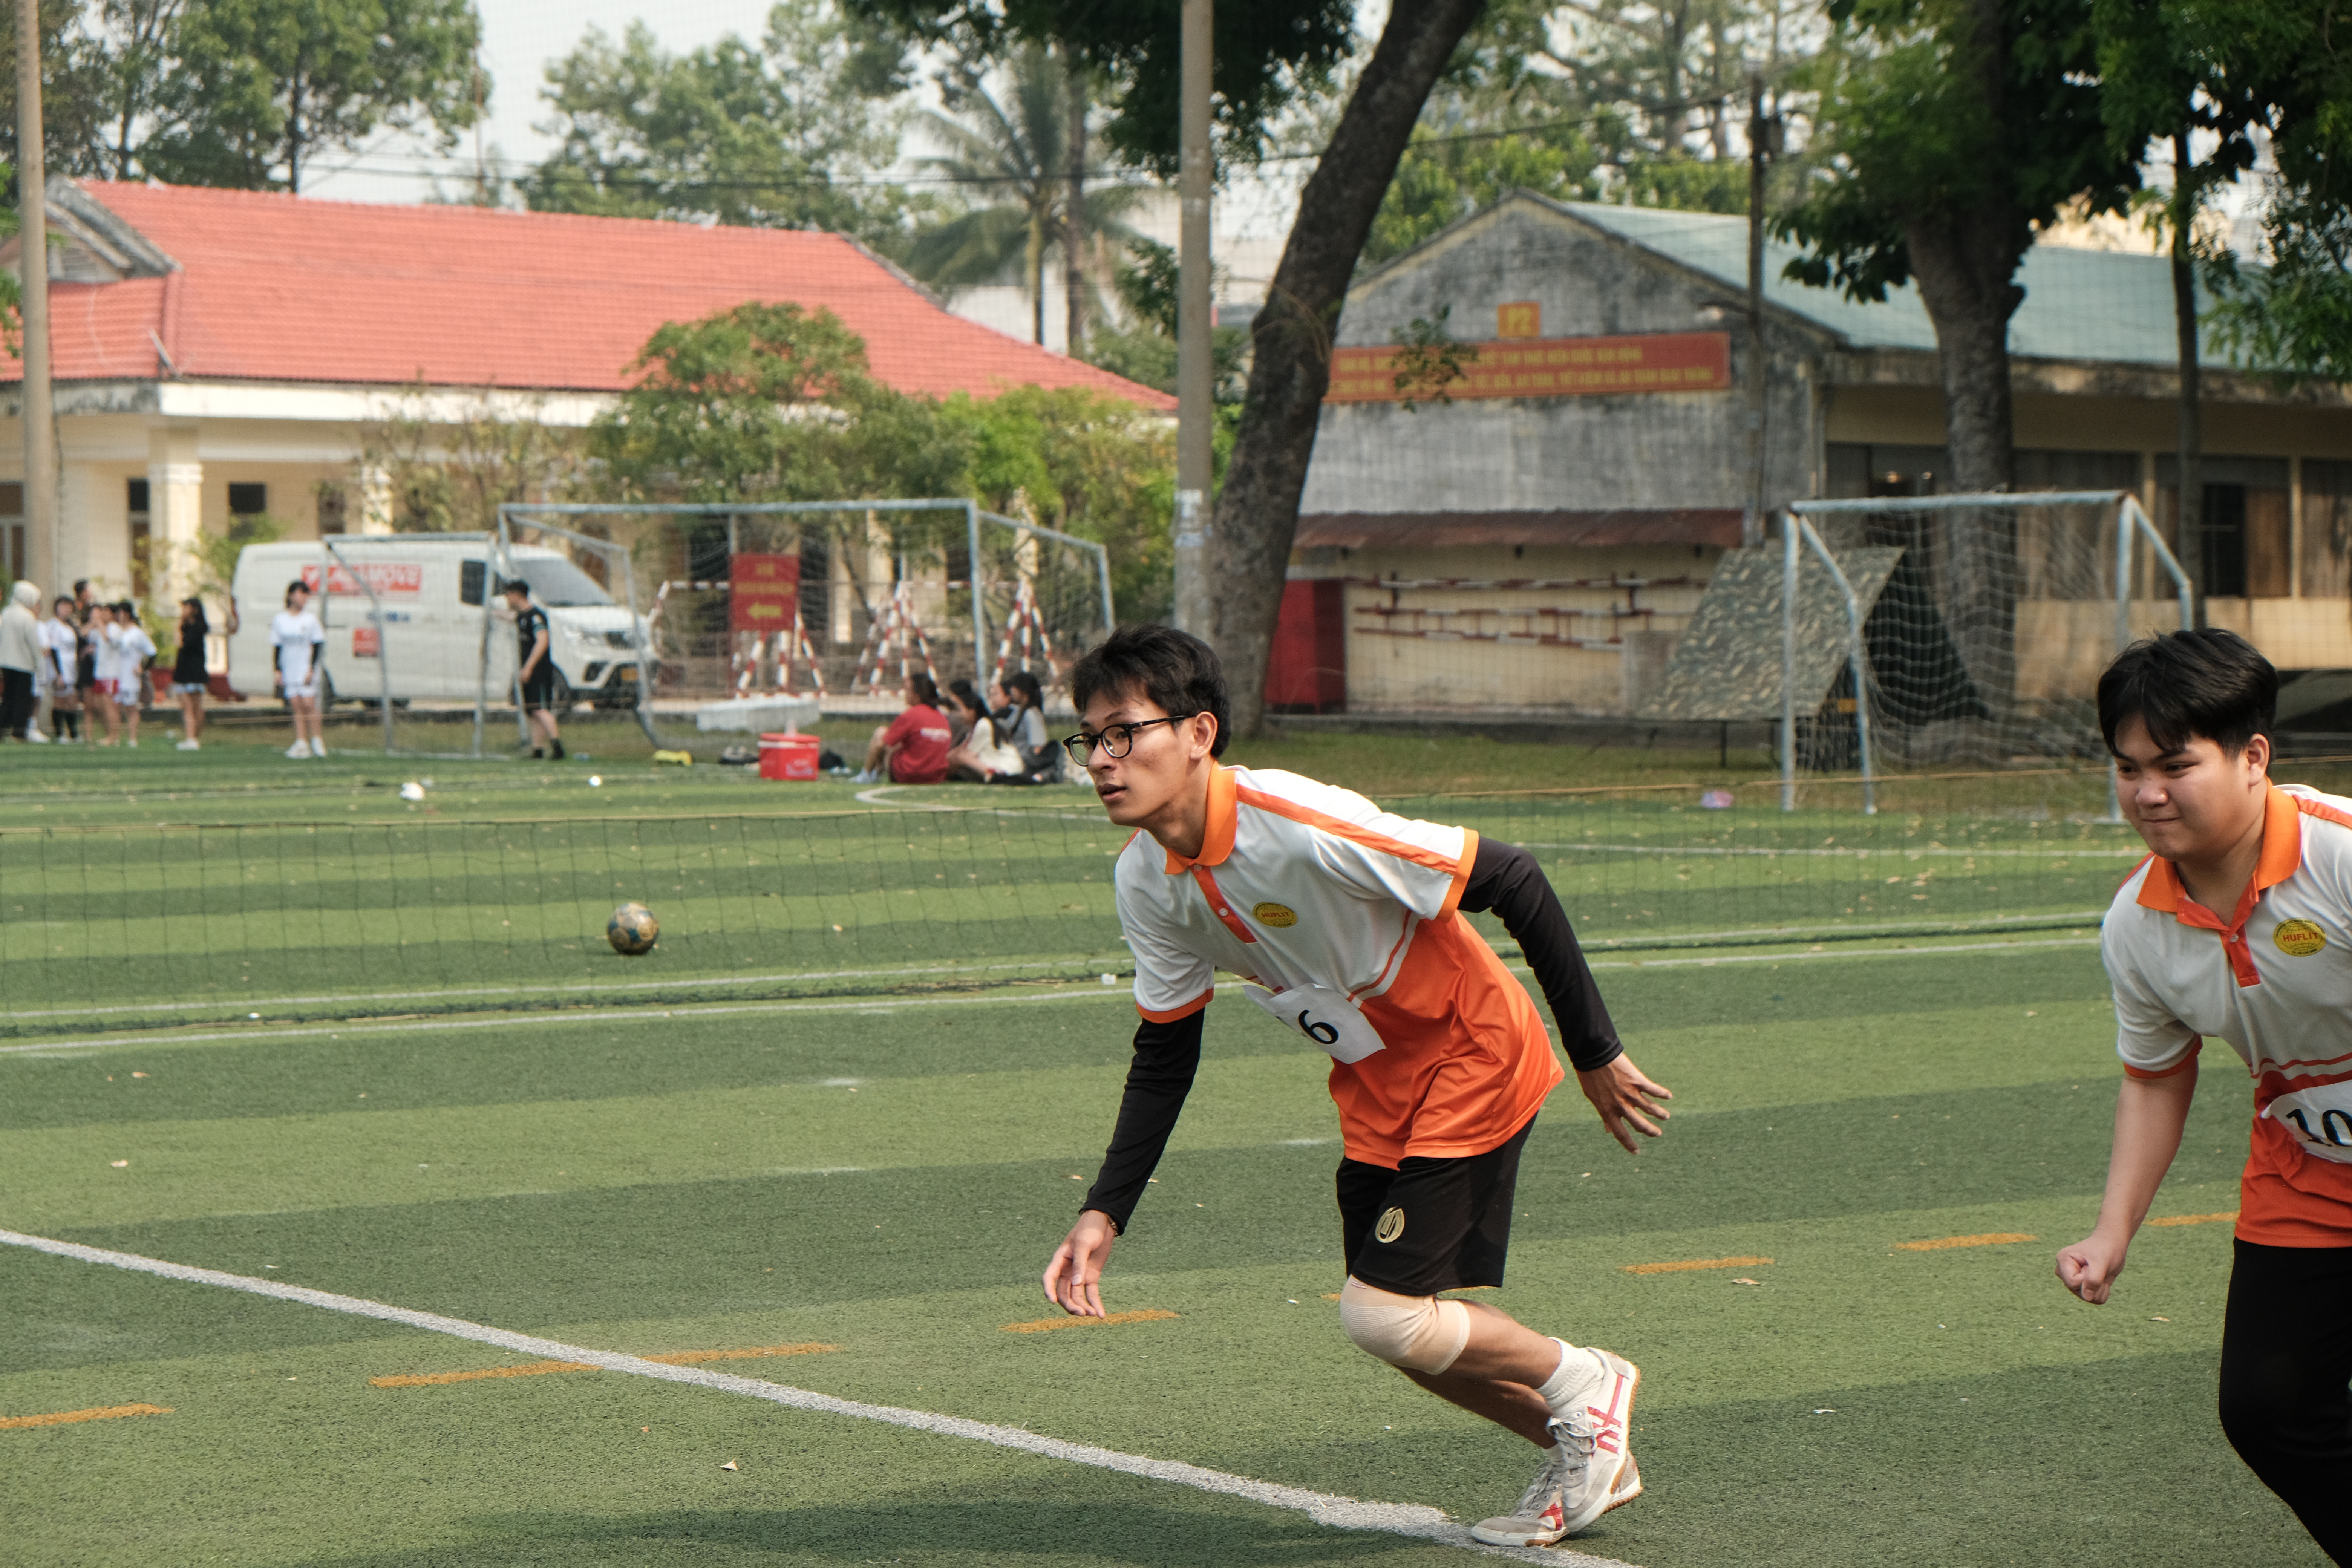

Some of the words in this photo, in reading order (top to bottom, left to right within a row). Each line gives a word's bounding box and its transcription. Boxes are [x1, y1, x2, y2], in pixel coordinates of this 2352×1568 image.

[1507, 307, 1532, 334] P2
[2283, 932, 2318, 942] HUFLIT
[1298, 1009, 1339, 1045] 6
[2286, 1109, 2352, 1147] 10
